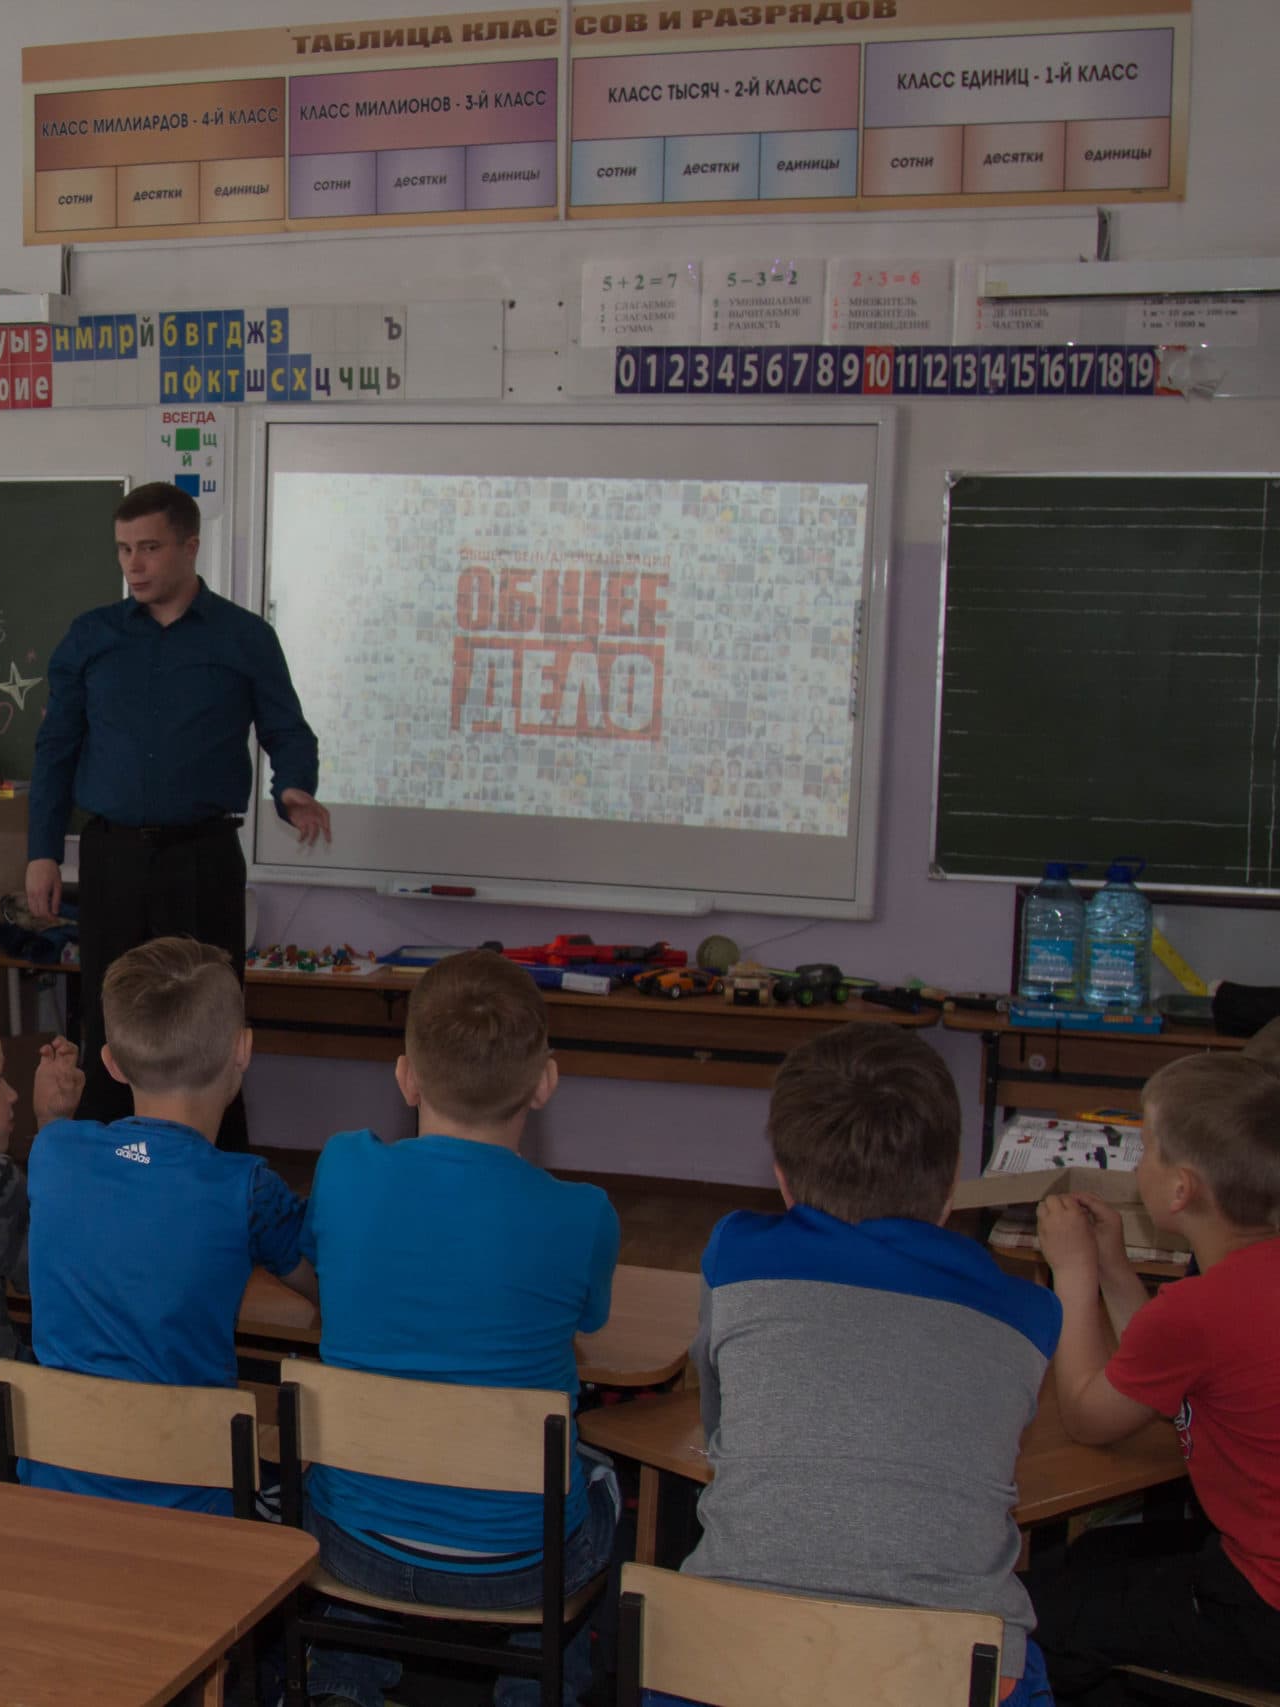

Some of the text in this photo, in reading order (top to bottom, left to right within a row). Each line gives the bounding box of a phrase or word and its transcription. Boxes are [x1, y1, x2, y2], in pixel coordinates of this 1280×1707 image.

[291, 24, 453, 55] ТАБЛИЦА
[658, 10, 682, 31] И
[691, 0, 897, 28] РАЗРЯДОВ
[896, 71, 956, 91] КЛАСС
[961, 67, 1029, 91] ЕДИНИЦ
[1044, 62, 1072, 85] 1-Й
[1077, 63, 1139, 83] КЛАСС
[607, 84, 663, 104] КЛАСС
[667, 80, 720, 101] ТЫСЯЧ
[734, 75, 760, 98] 2-Й
[765, 76, 823, 96] КЛАСС
[299, 102, 350, 121] КЛАСС
[355, 95, 451, 118] МИЛЛИОНОВ
[465, 89, 489, 112] 3-Й
[494, 90, 547, 109] КЛАСС
[42, 119, 88, 137] КЛАСС
[93, 112, 189, 135] МИЛЛИАРДОВ
[201, 107, 224, 127] 4-Й
[228, 107, 279, 126] КЛАСС
[890, 155, 934, 170] сотни
[982, 151, 1044, 167] десятки
[1084, 147, 1152, 163] единицы
[596, 165, 638, 180] сотни
[683, 161, 740, 177] десятки
[776, 158, 840, 174] единицы
[393, 174, 447, 189] десятки
[481, 169, 540, 184] единицы
[214, 183, 270, 198] единицы
[313, 179, 351, 192] сотни
[58, 194, 93, 206] сотни
[132, 188, 183, 203] десятки
[602, 276, 613, 292] 5
[634, 274, 645, 289] 2
[667, 272, 678, 288] 7
[727, 272, 737, 287] 5
[756, 271, 767, 286] 3
[787, 270, 798, 285] 2
[851, 271, 862, 287] 2
[878, 271, 889, 286] 3
[910, 270, 920, 286] 6
[620, 353, 1153, 387] 0 1 2 3 4 5 6 7 8 9 10 11 12 13 14 15 16 17 18 19
[162, 411, 216, 425] ВСЕГДА
[455, 565, 670, 638] ОБЩЕЕ
[458, 647, 656, 737] ДЕЛО
[114, 1147, 151, 1165] adidas
